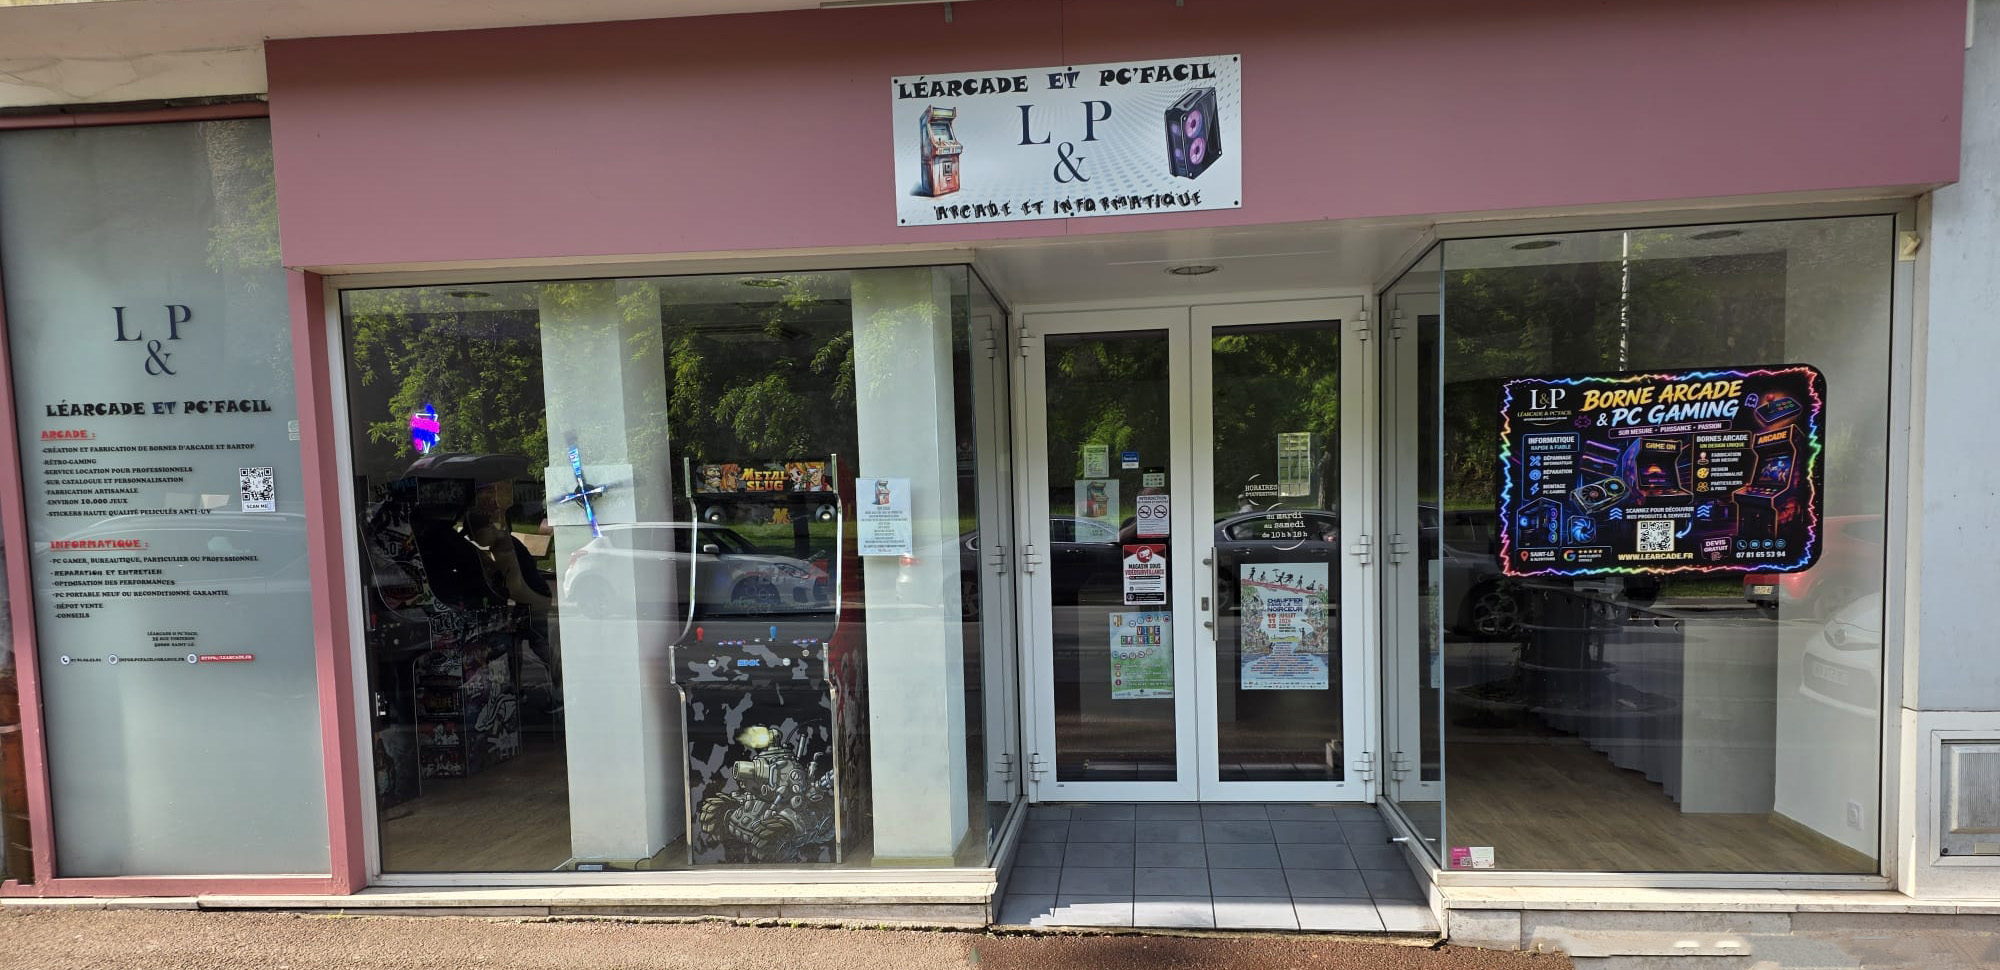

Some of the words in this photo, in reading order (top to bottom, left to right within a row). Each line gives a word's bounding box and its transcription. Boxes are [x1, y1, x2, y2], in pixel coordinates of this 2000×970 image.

[898, 76, 1028, 99] LÉARCADE
[1048, 70, 1080, 90] ET
[1100, 62, 1216, 87] PC'FACIL
[1017, 104, 1051, 146] L
[1081, 100, 1112, 142] P
[1053, 141, 1091, 184] &
[934, 199, 1012, 221] ARCADE
[1021, 200, 1044, 216] ET
[1053, 189, 1202, 215] INFORMATIQUE
[112, 306, 142, 342] L
[164, 304, 192, 340] P
[144, 339, 176, 376] &
[1579, 386, 1656, 412] BORNE
[1658, 380, 1744, 403] ARCADE
[46, 399, 146, 417] LÉARCADE
[151, 402, 176, 415] ET
[184, 399, 272, 415] PC'FACIL
[1596, 412, 1608, 426] &
[1612, 406, 1644, 427] PC
[1648, 400, 1740, 424] GAMING
[41, 430, 88, 440] ARCADE
[1528, 436, 1575, 444] INFORMATIQUE
[1758, 431, 1788, 444] ARCADE
[740, 468, 788, 480] METAL
[746, 480, 784, 491] SLUG
[1274, 520, 1306, 528] samedi
[50, 540, 141, 550] INFORMATIQUE
[1618, 552, 1694, 560] WWW.LEARCADE.FR
